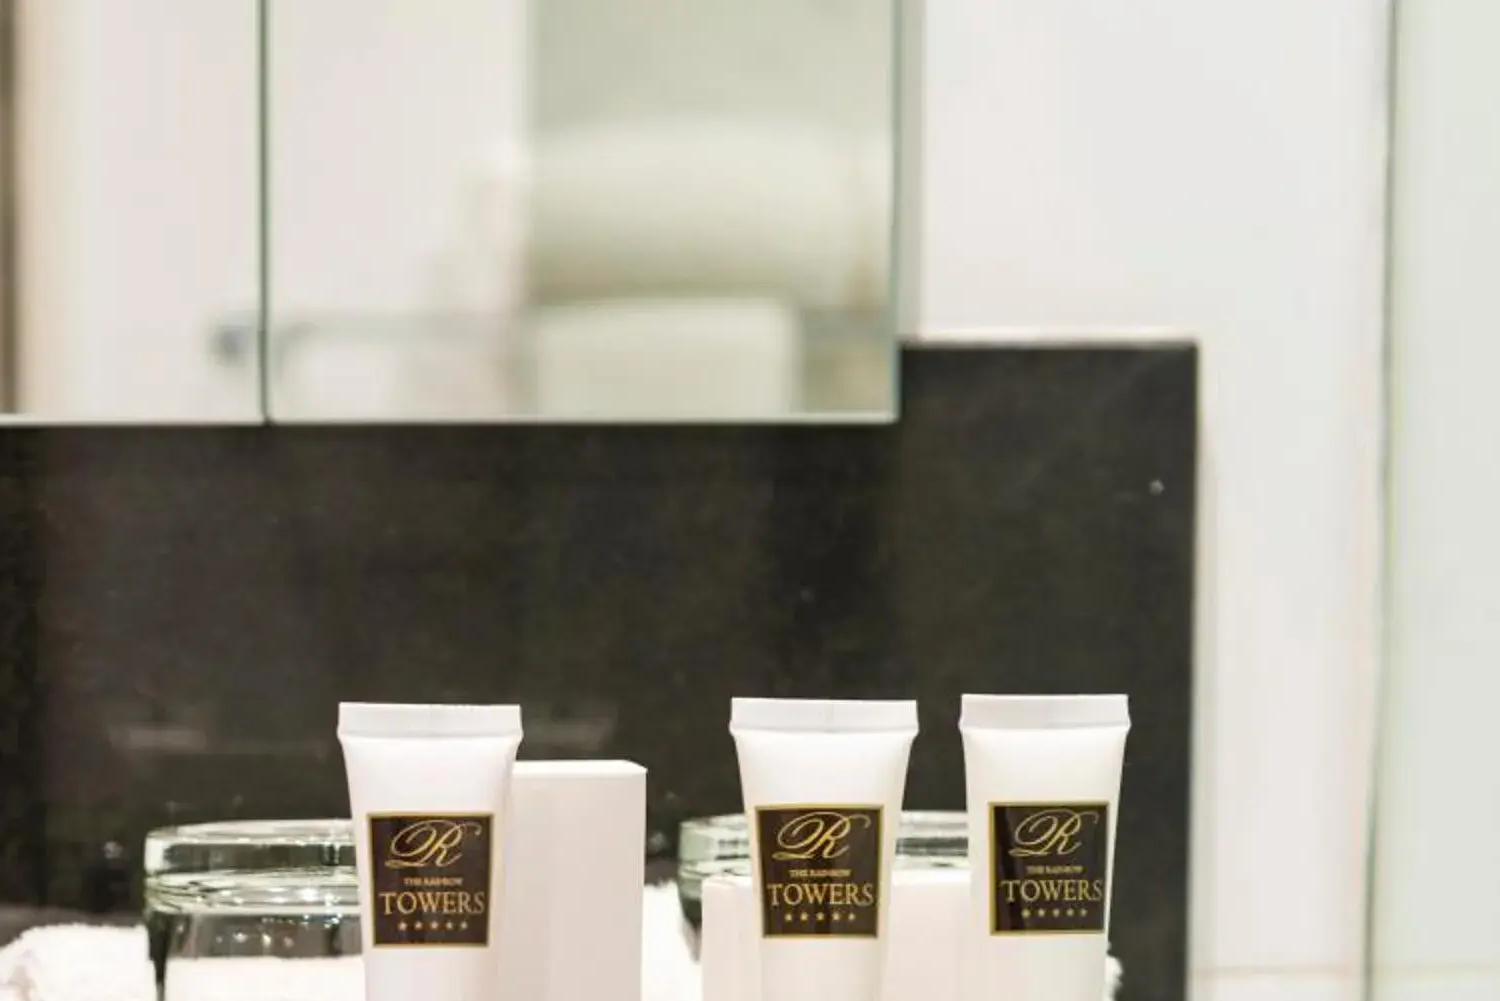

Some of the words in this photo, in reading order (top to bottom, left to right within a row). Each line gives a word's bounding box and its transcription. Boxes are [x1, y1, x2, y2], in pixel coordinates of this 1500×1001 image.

[767, 883, 874, 907] TOWERS
[1001, 878, 1104, 903] TOWERS
[379, 891, 485, 916] TOWERS
